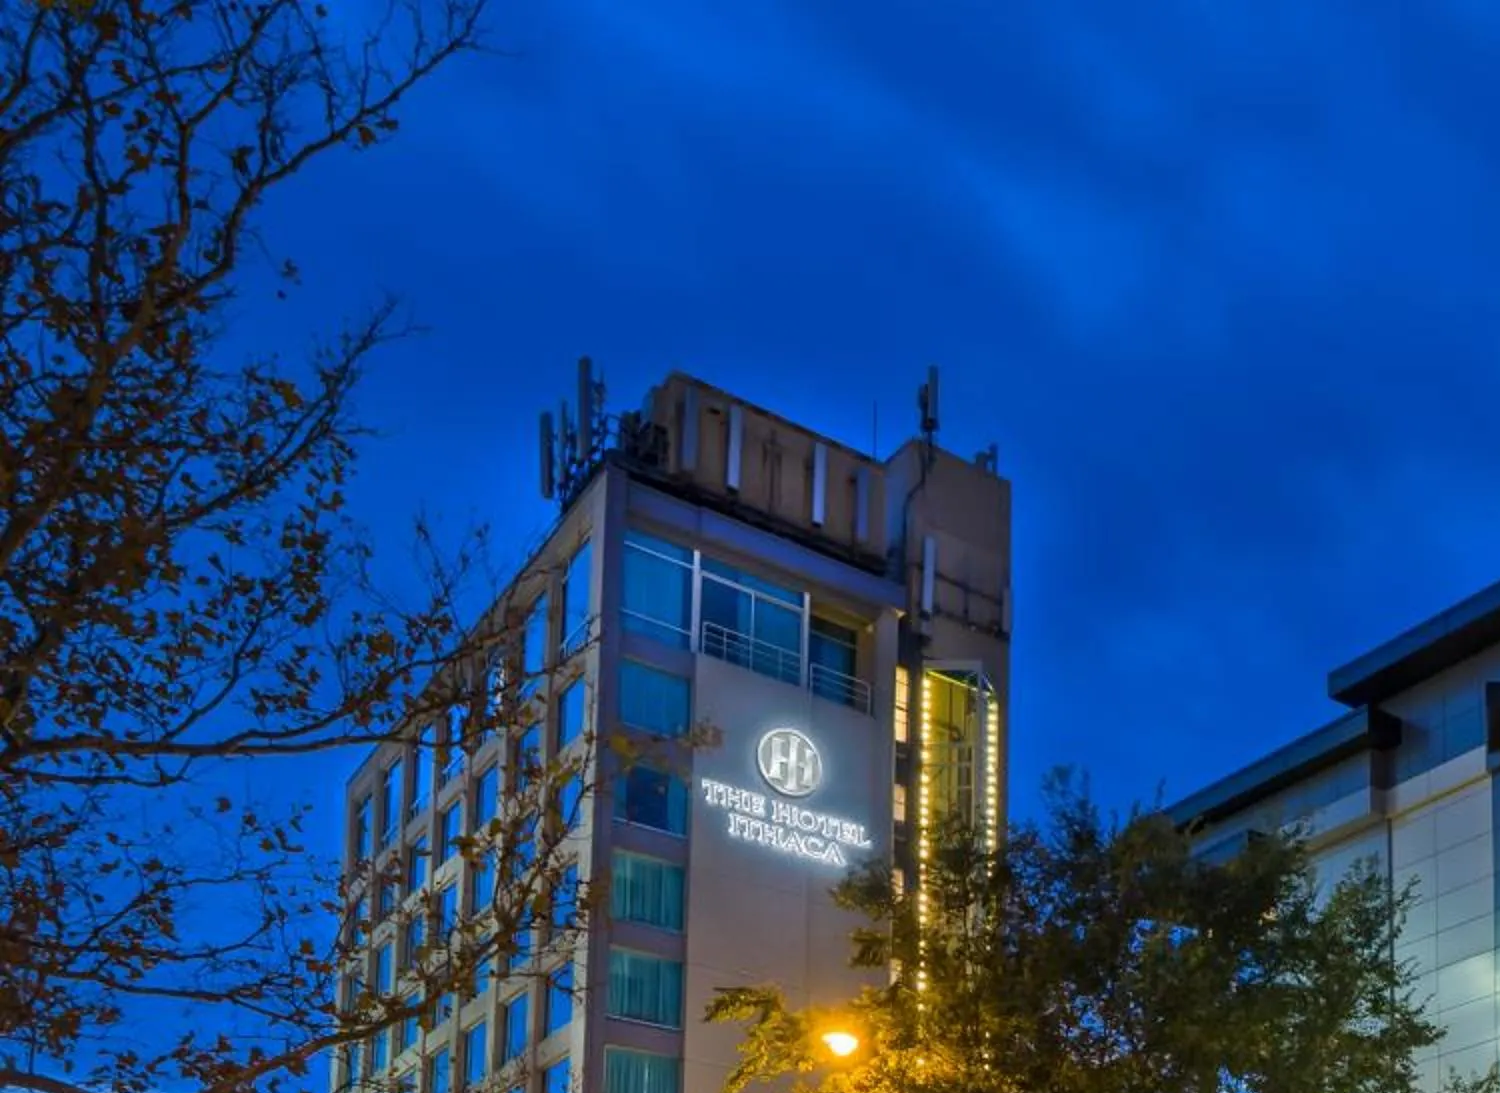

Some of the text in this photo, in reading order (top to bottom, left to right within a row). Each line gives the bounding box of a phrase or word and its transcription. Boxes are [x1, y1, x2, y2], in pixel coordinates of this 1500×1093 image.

[701, 778, 872, 849] THE HOTEL
[727, 813, 847, 867] ITHACA
